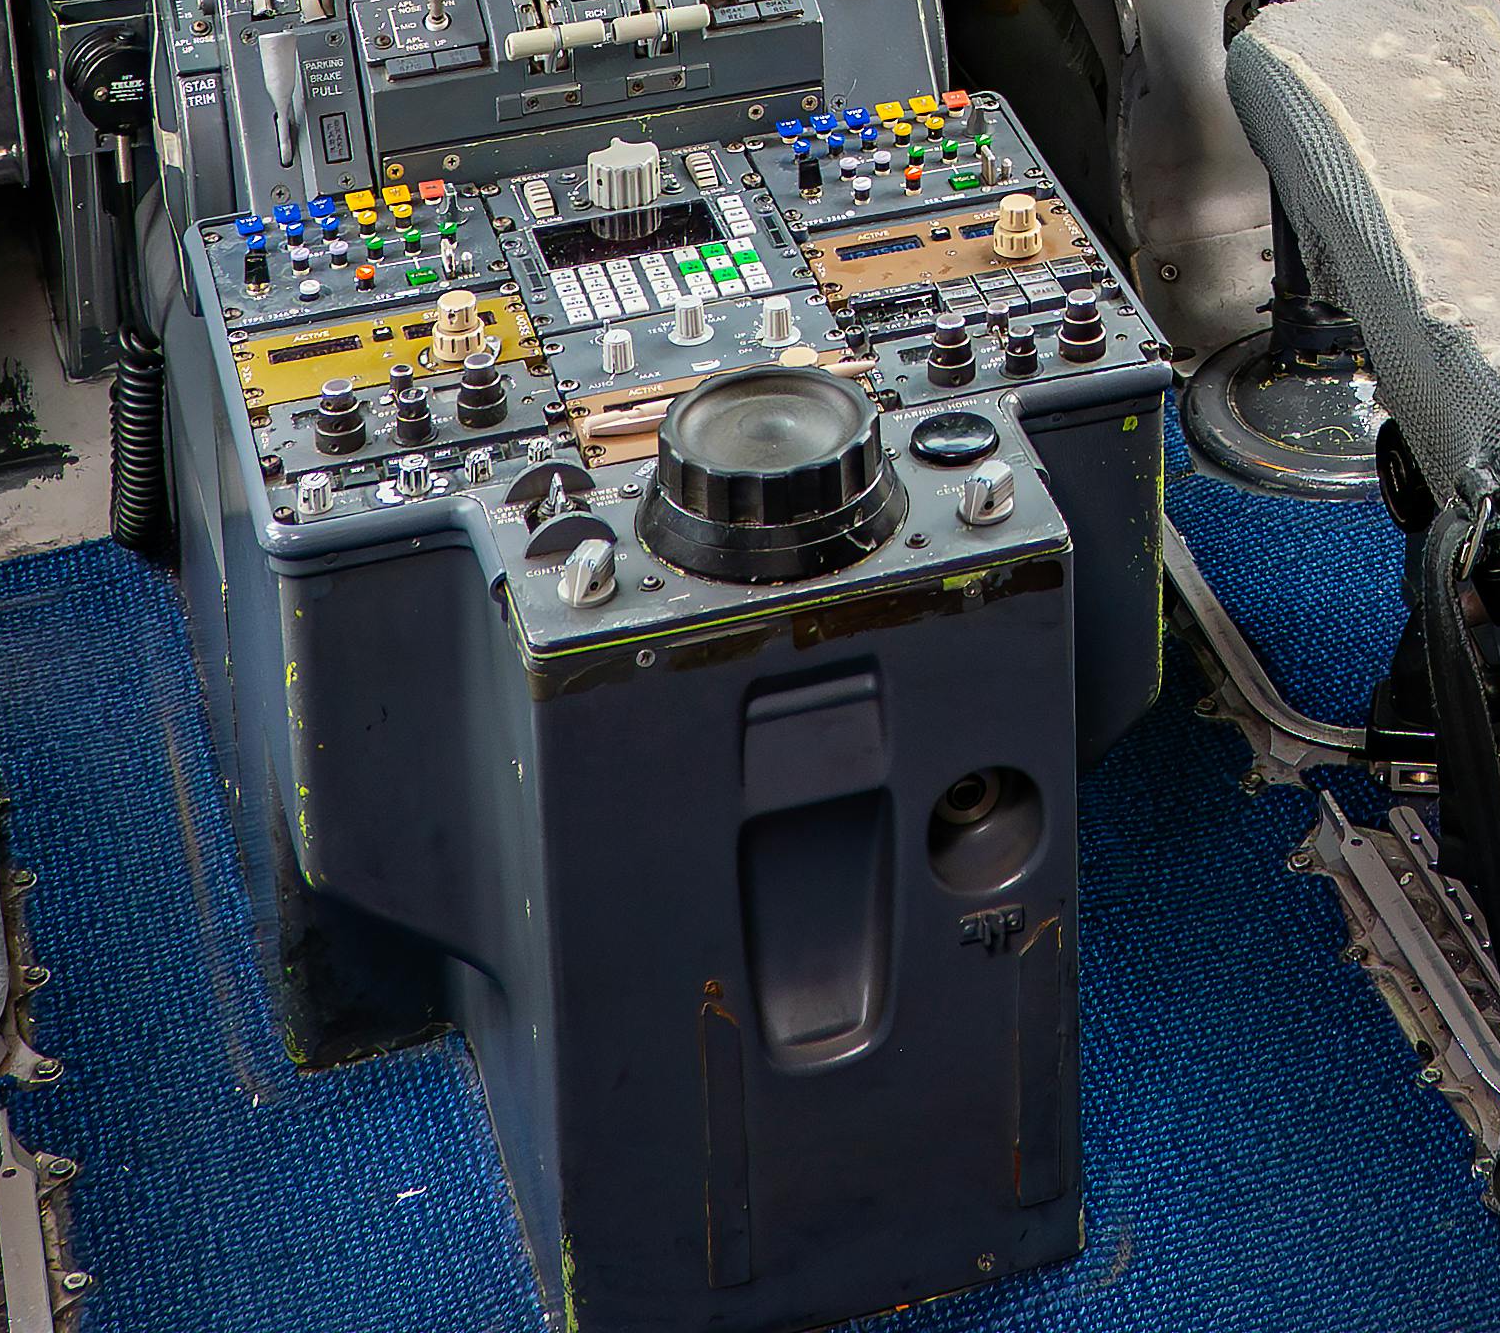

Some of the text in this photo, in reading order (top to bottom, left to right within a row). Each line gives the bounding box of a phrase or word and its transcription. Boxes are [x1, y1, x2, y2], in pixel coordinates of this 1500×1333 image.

[767, 0, 792, 7] BRAKE
[585, 9, 606, 18] RICH
[722, 7, 746, 15] BRAKE
[304, 59, 344, 70] PARKING
[310, 71, 342, 82] BRAKE
[186, 79, 216, 92] STAB
[312, 85, 342, 97] PULL
[186, 94, 216, 107] TRIM
[858, 231, 889, 241] ACTIVE
[293, 331, 330, 343] ACTIVE
[588, 381, 614, 390] AUTO
[893, 399, 977, 421] WARNING HORN
[585, 488, 618, 498] LOWER
[591, 493, 621, 503] RIGHT
[490, 505, 525, 517] LOWER
